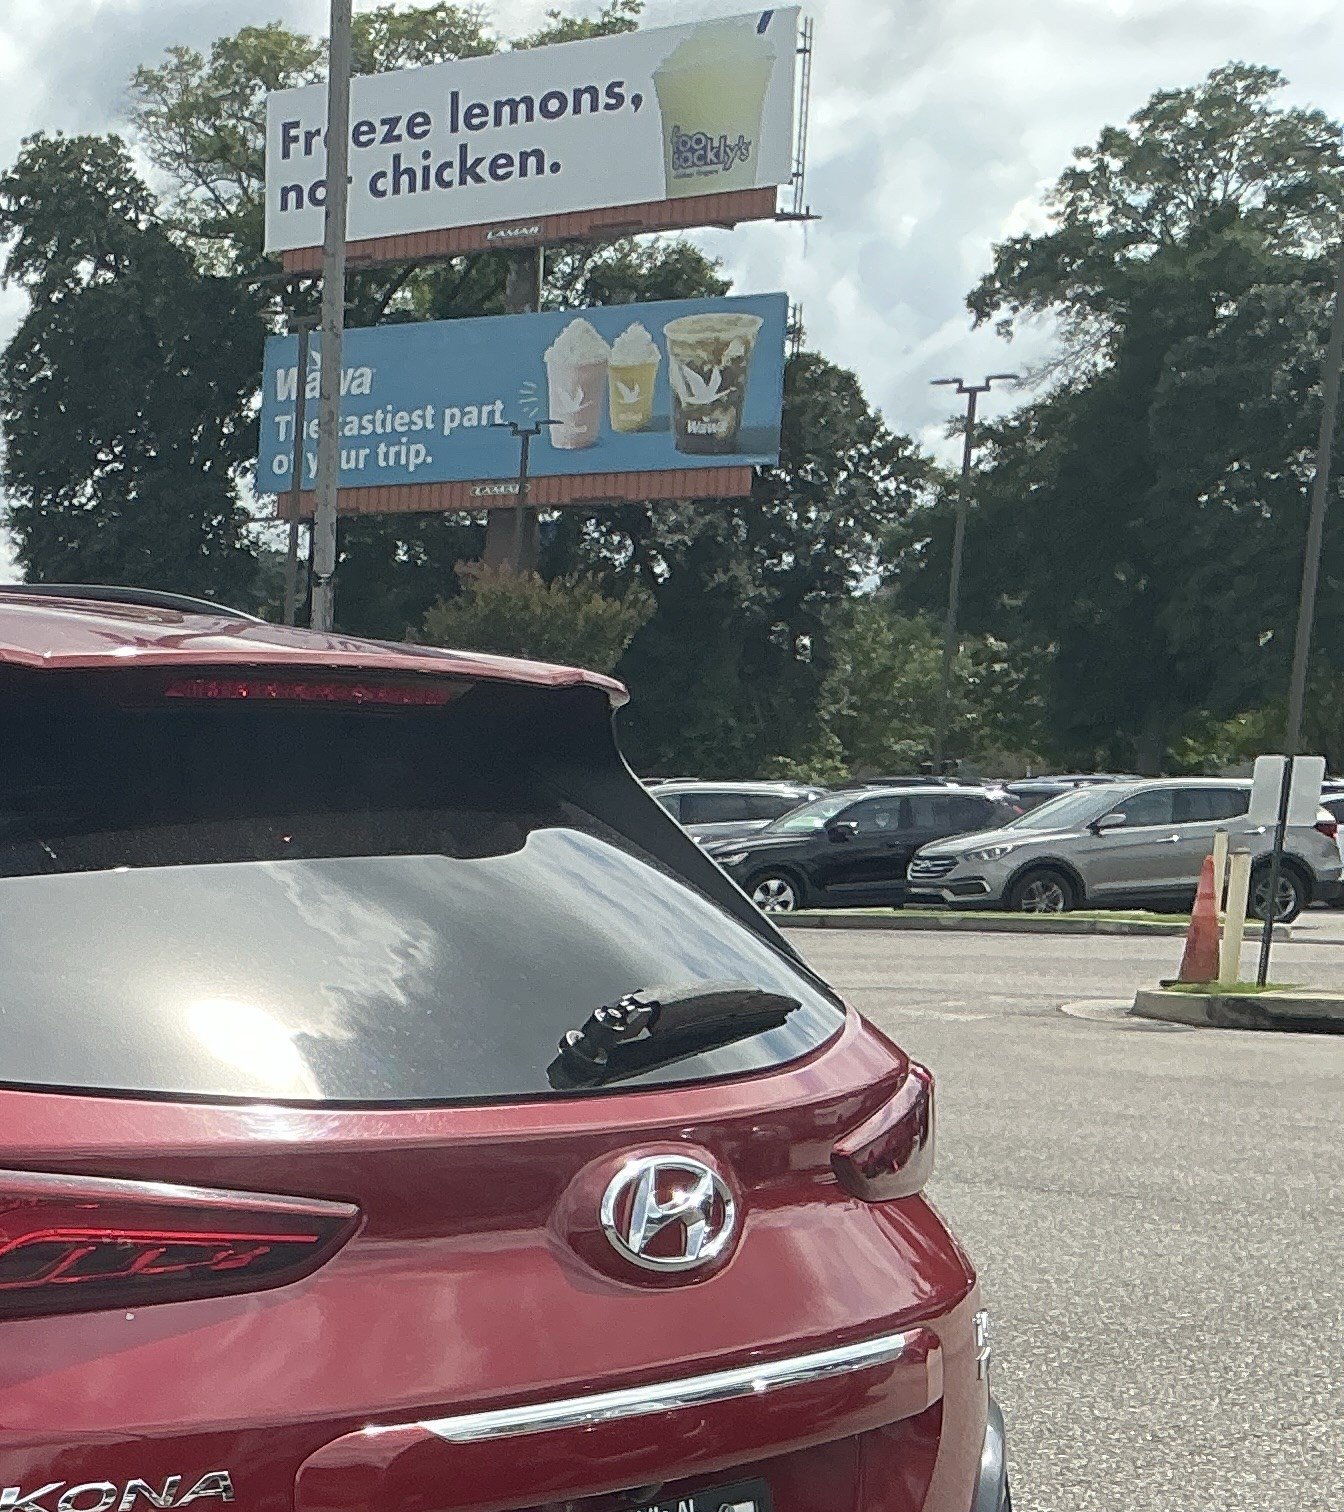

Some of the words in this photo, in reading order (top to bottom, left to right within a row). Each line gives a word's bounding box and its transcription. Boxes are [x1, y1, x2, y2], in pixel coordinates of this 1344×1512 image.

[280, 111, 432, 161] Freze
[449, 80, 644, 134] lemons,
[280, 176, 353, 212] no
[368, 143, 562, 199] chicken.
[338, 404, 436, 437] astiest
[443, 399, 509, 436] part
[306, 447, 370, 479] yur
[377, 437, 433, 473] trip.
